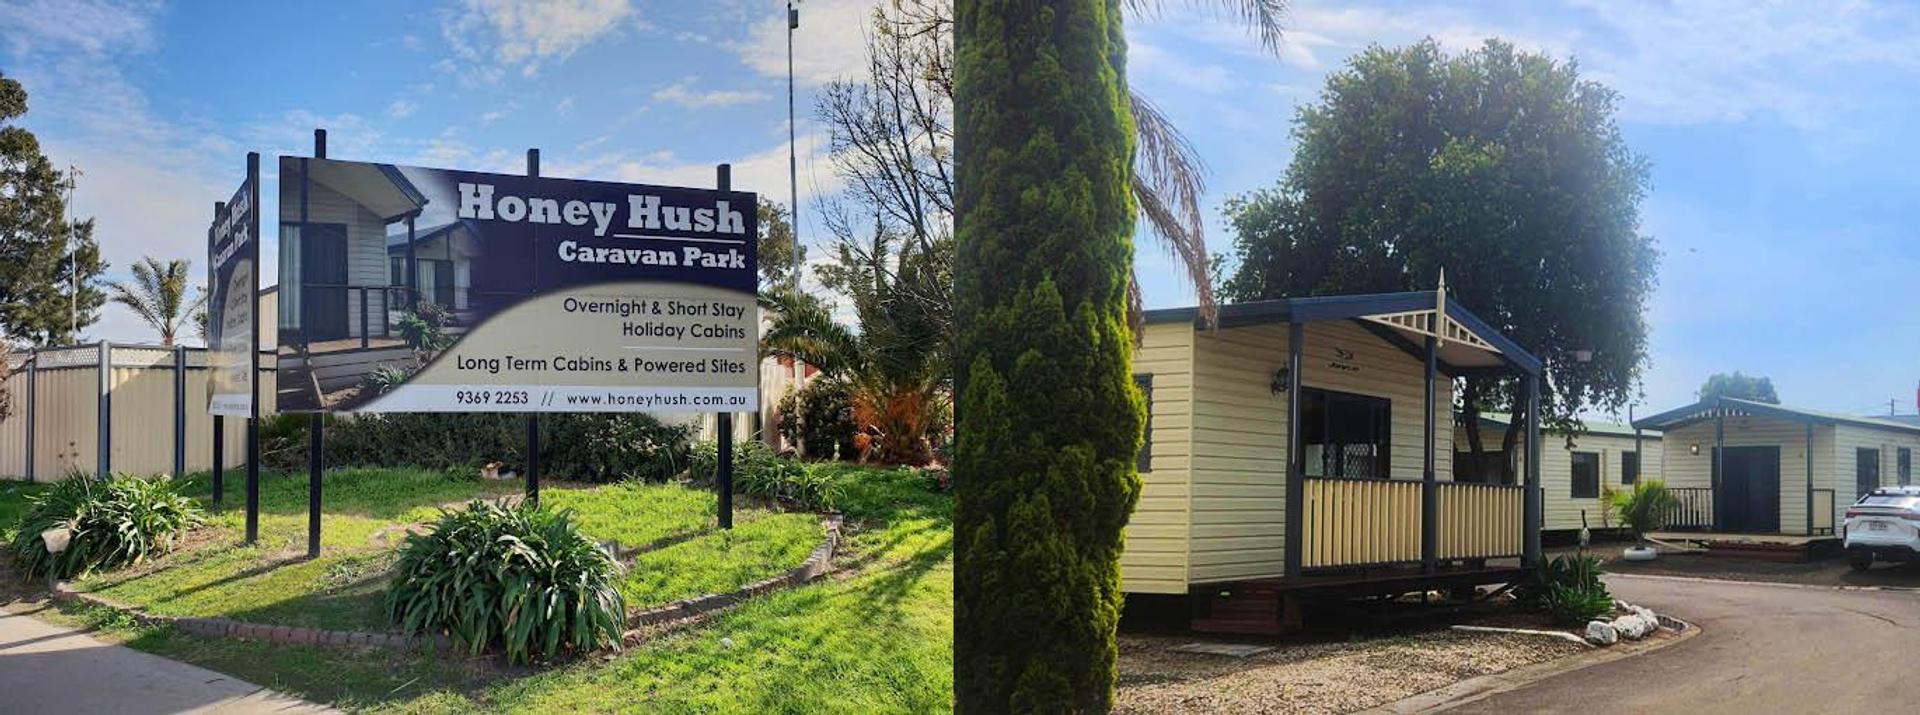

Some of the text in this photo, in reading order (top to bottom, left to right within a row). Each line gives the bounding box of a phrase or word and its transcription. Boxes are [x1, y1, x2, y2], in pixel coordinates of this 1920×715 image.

[458, 182, 746, 237] Honey Hush
[557, 240, 746, 269] Caravan Park
[563, 298, 745, 320] Overnight & Short Stay
[623, 322, 746, 340] Holiday Cabins
[457, 355, 746, 374] Long Term Cabins & Powered Sites
[456, 391, 491, 405] 9369
[495, 391, 529, 405] 2253
[567, 393, 746, 407] www.honeyhush.com.au
